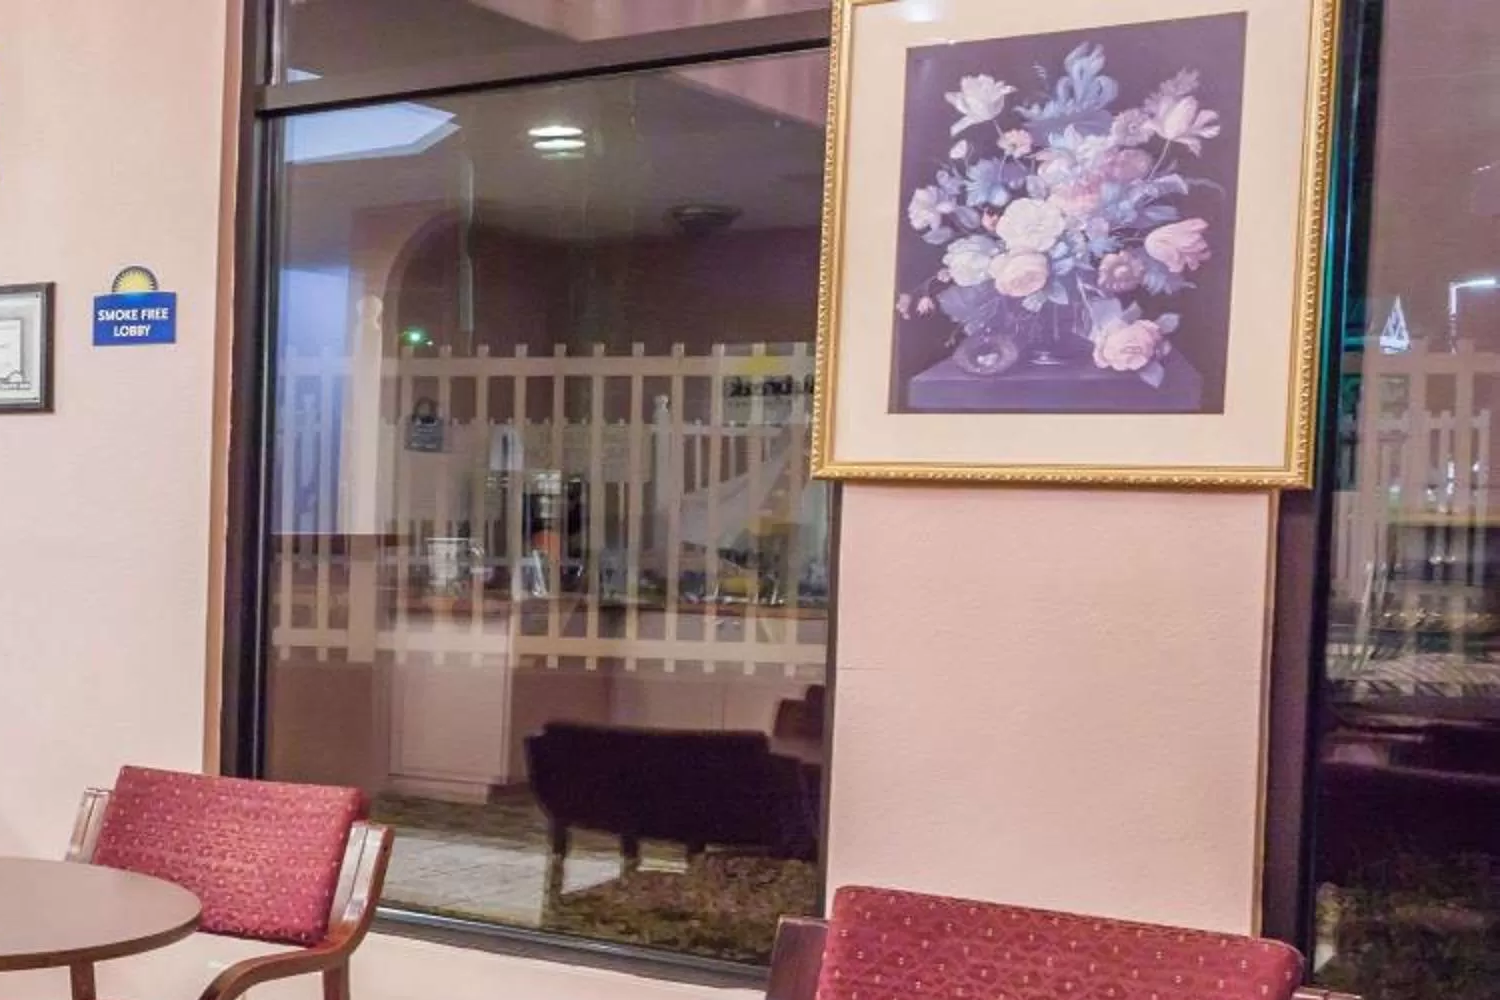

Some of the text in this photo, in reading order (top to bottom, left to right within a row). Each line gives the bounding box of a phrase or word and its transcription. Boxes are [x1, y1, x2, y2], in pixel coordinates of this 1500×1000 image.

[97, 307, 169, 321] SMOKE FREE
[113, 324, 151, 337] LOBBY
